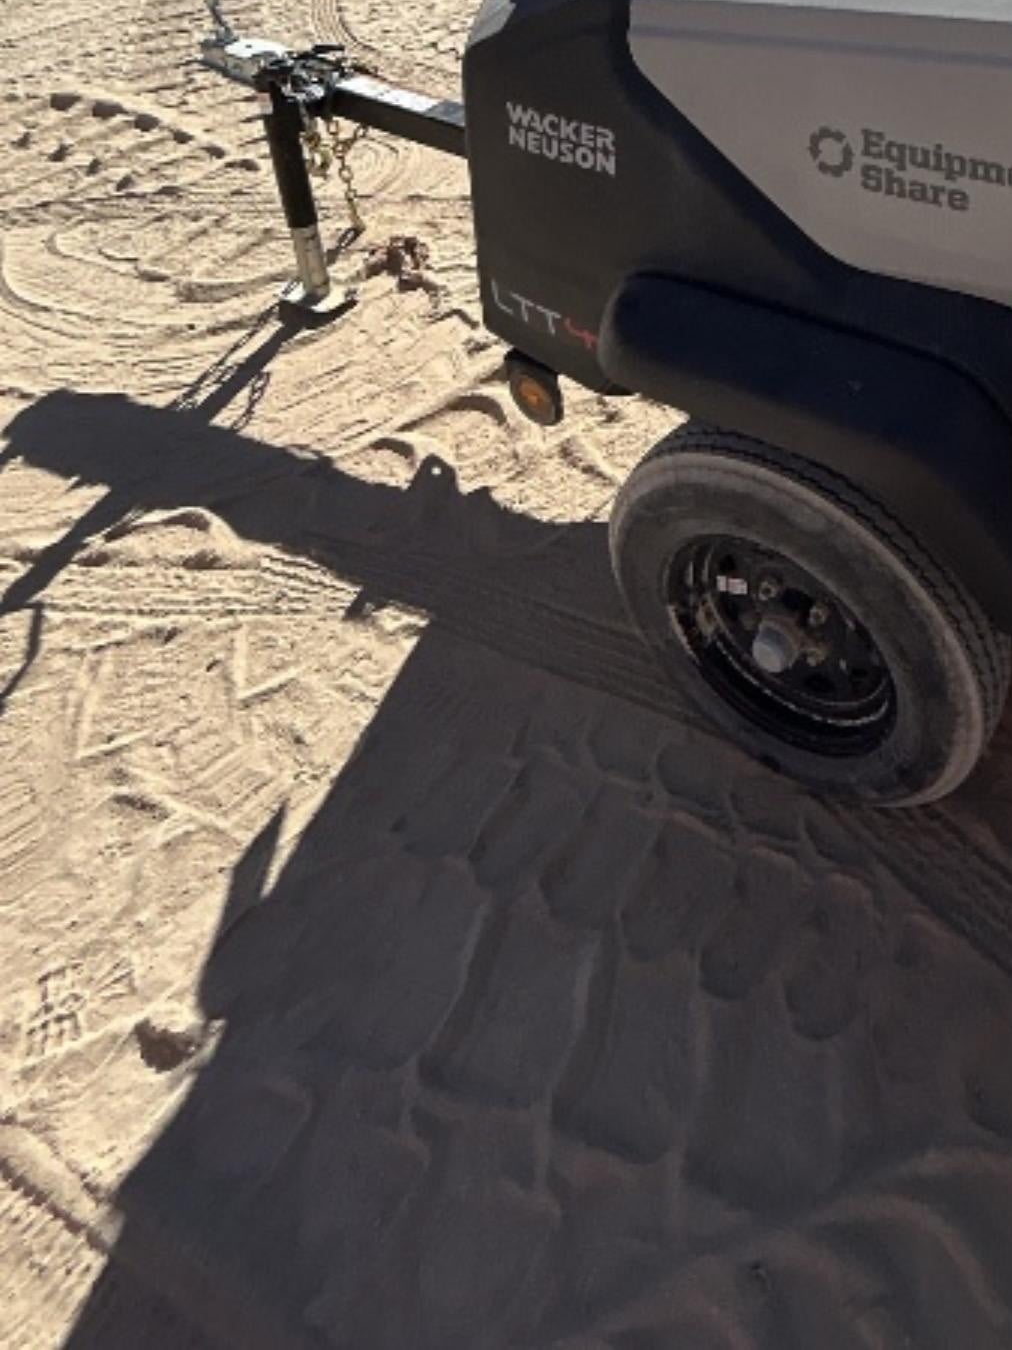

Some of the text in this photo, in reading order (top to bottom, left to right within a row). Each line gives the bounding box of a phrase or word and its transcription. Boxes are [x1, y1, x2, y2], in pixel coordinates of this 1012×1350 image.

[505, 101, 616, 151] WACKER
[508, 125, 617, 177] NEUSON
[860, 163, 970, 211] Share
